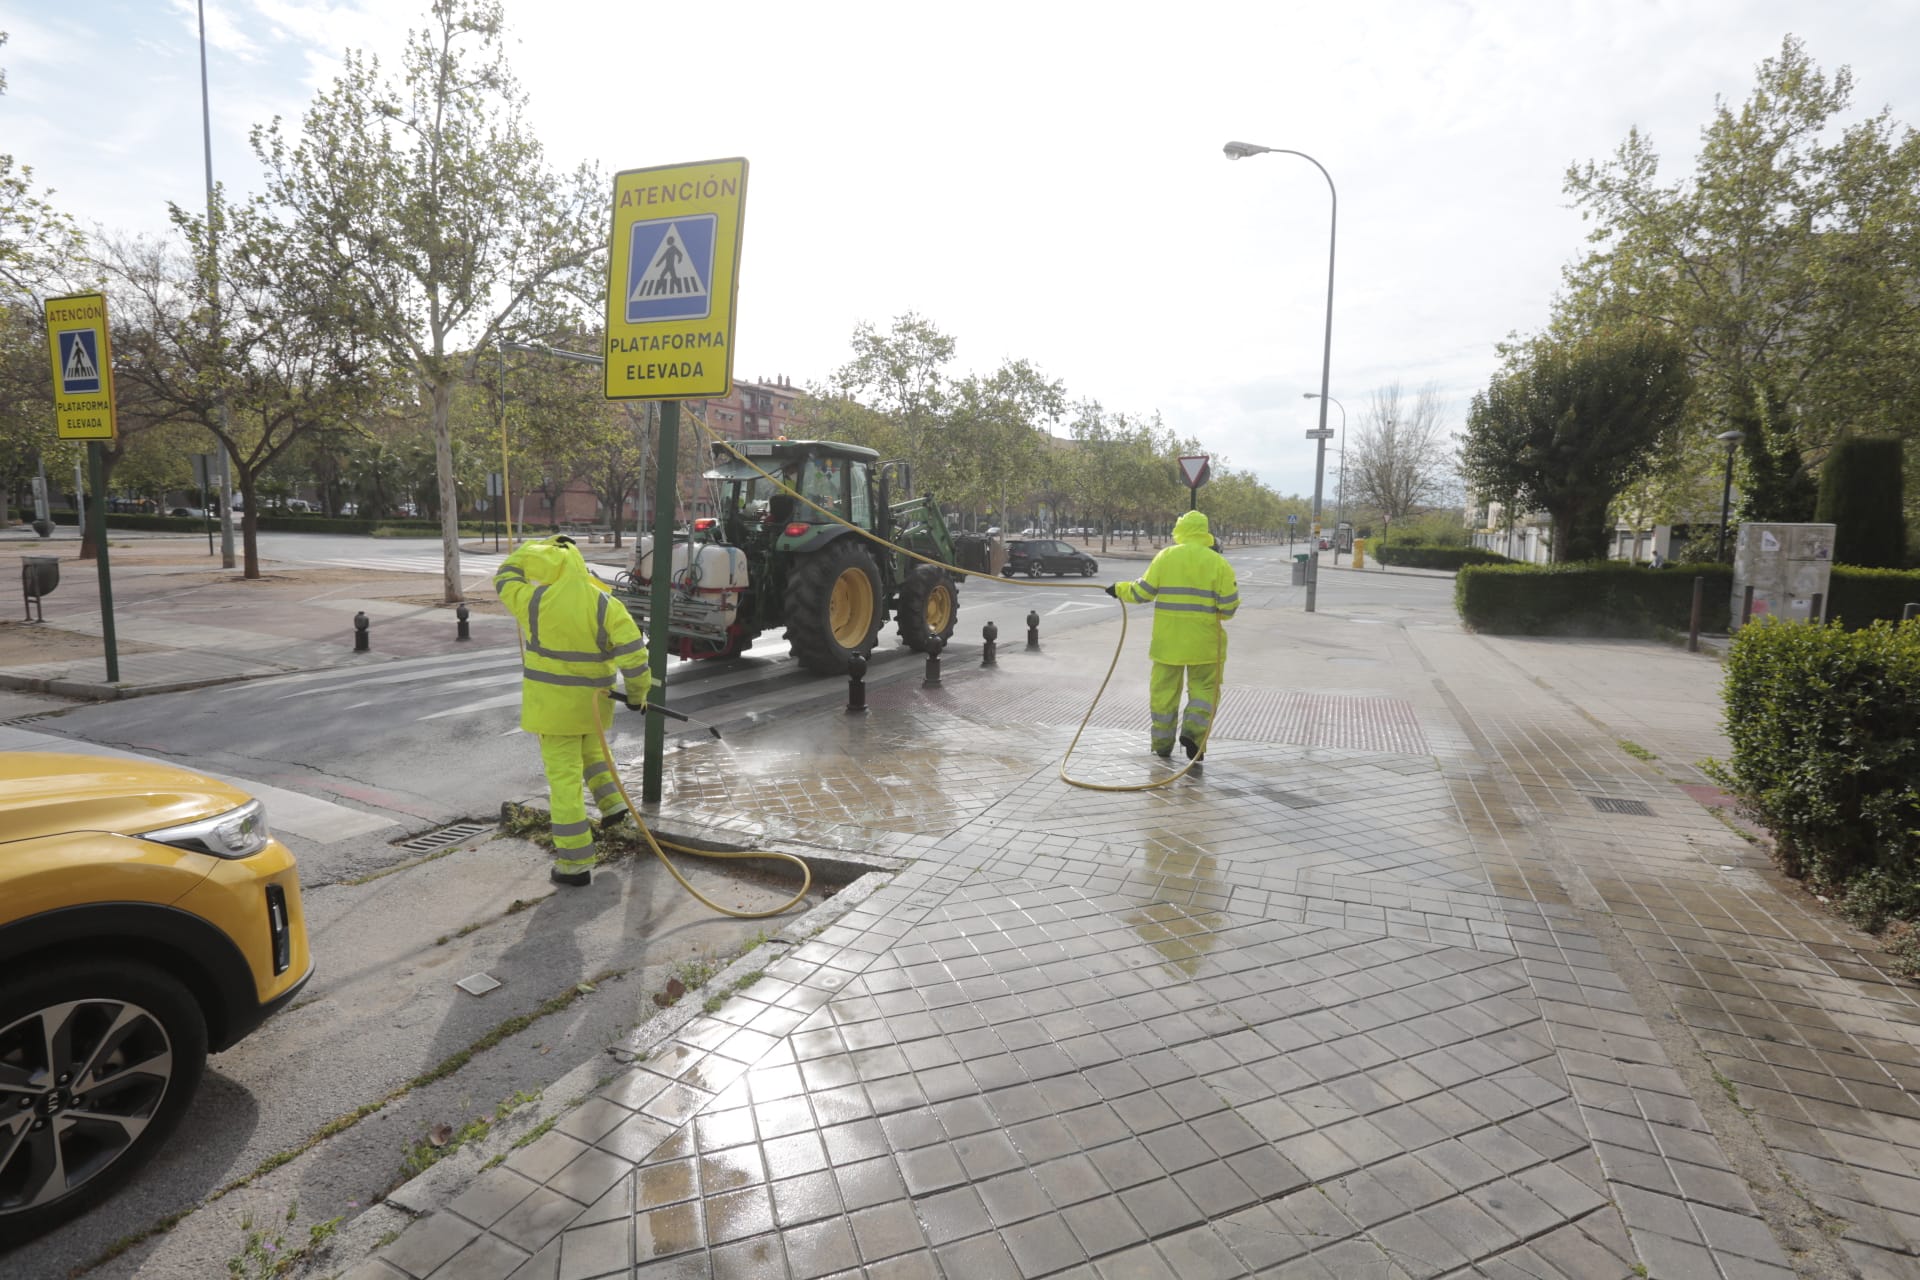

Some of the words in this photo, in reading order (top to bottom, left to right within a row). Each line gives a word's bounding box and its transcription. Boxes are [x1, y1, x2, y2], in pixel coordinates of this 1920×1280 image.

[620, 174, 737, 208] ATENCIÓN
[50, 304, 101, 322] ATENCIÓN
[610, 331, 724, 353] PLATAFORMA
[626, 362, 704, 380] ELEVADA
[58, 401, 109, 412] PLATAFORMA
[67, 418, 102, 429] ELEVADA
[48, 1091, 58, 1114] KIA
